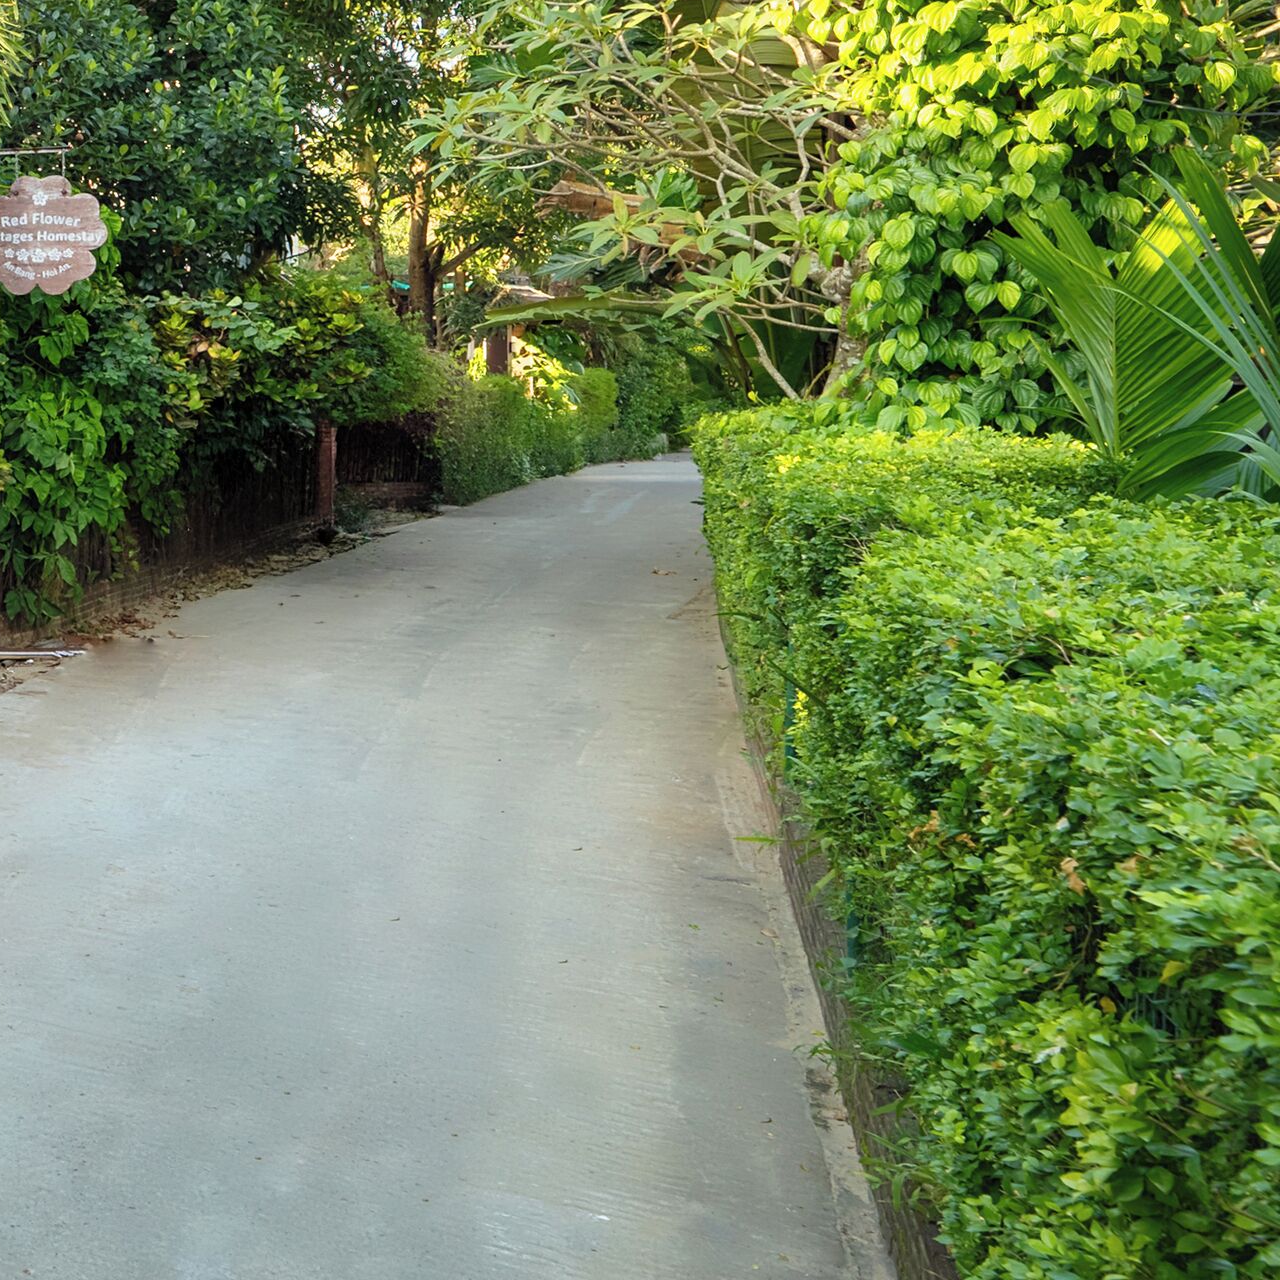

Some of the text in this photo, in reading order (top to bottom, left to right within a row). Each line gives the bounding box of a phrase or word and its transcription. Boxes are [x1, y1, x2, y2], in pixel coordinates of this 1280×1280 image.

[0, 212, 81, 227] Red Flower
[37, 231, 103, 242] Homestay
[3, 261, 15, 271] An
[15, 267, 35, 280] Bang
